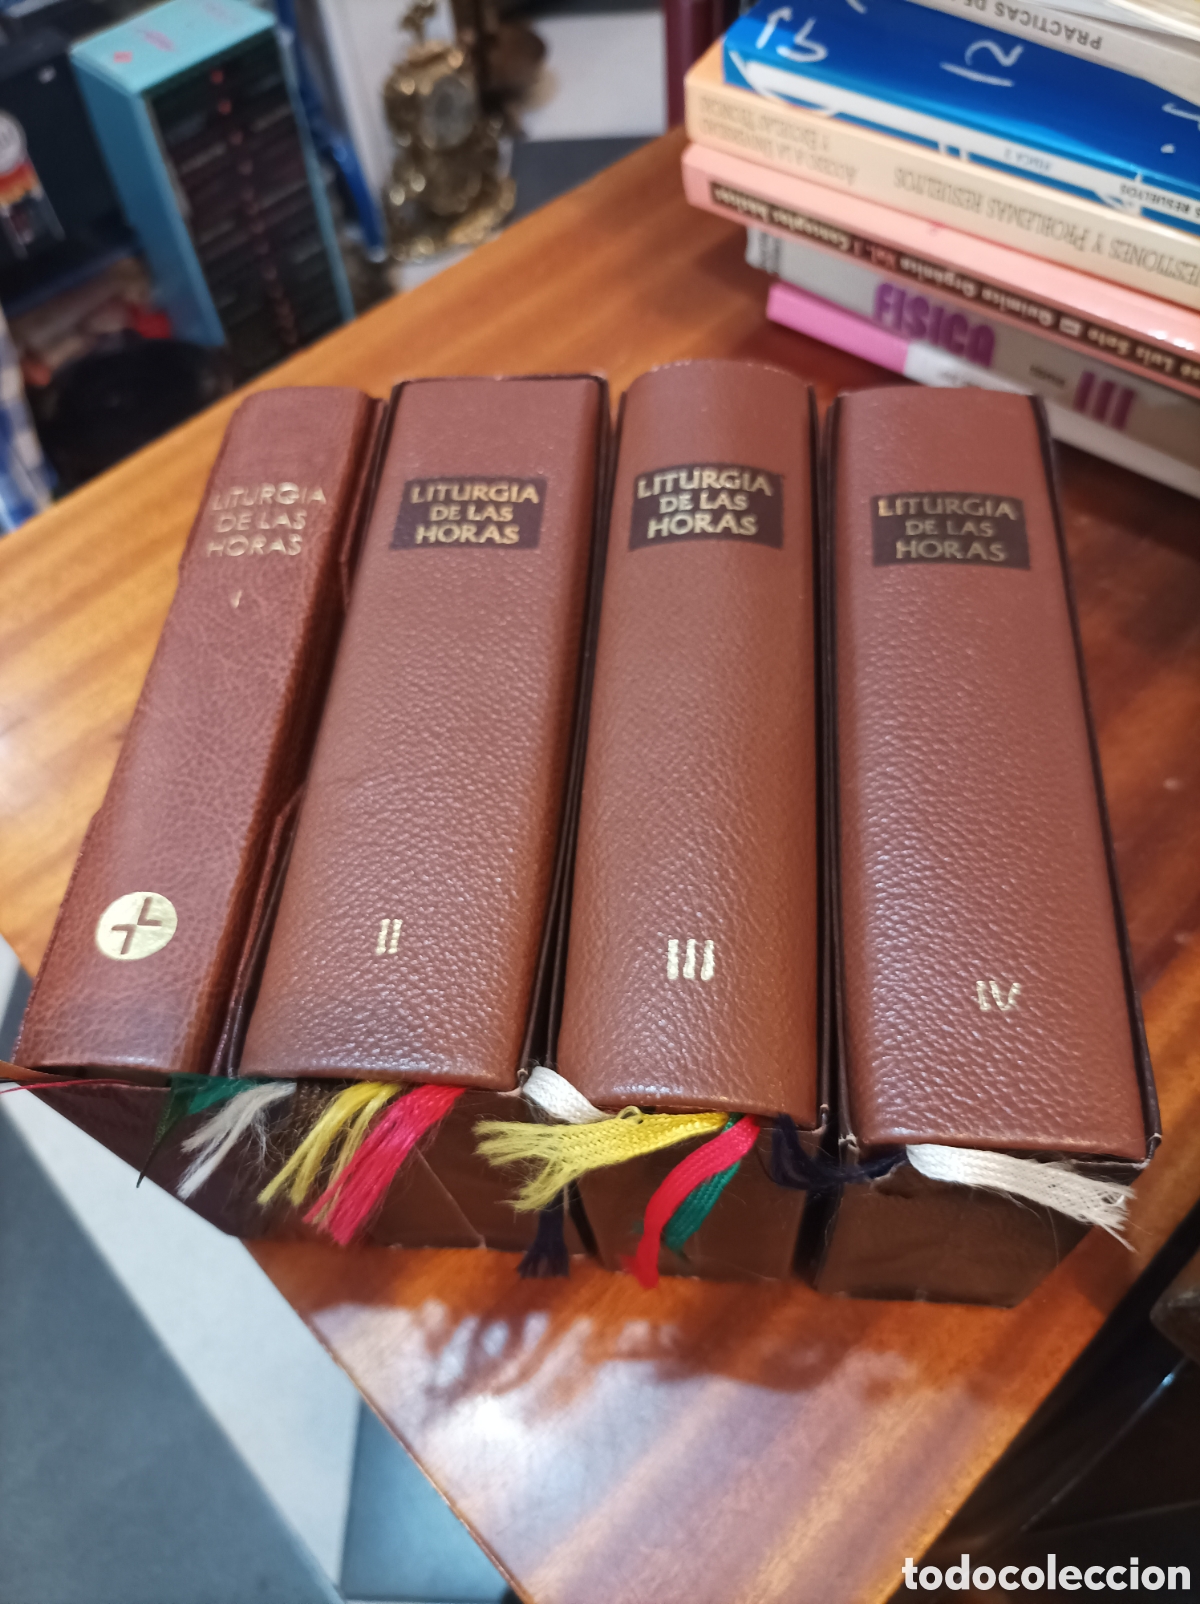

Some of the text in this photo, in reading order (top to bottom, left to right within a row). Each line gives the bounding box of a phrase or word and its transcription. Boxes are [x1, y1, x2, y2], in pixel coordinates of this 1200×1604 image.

[894, 166, 982, 215] RESUELTOS
[987, 194, 1088, 251] PROBLEMAS
[1091, 233, 1103, 252] Y
[1073, 370, 1138, 431] III
[410, 481, 540, 504] LITURGIA
[637, 467, 774, 499] LITURGIA
[211, 482, 326, 511] LITURGIA
[659, 490, 748, 514] DE LAS
[215, 509, 307, 532] DE LAS
[429, 503, 514, 522] DE LAS
[877, 497, 1017, 521] LITURGIA
[414, 523, 520, 545] HORAS
[646, 511, 758, 539] HORAS
[905, 519, 995, 537] DE LAS
[206, 534, 302, 557] HORAS
[895, 539, 1007, 562] HORAS
[375, 918, 403, 955] II
[666, 938, 715, 982] III
[976, 980, 1021, 1012] IV
